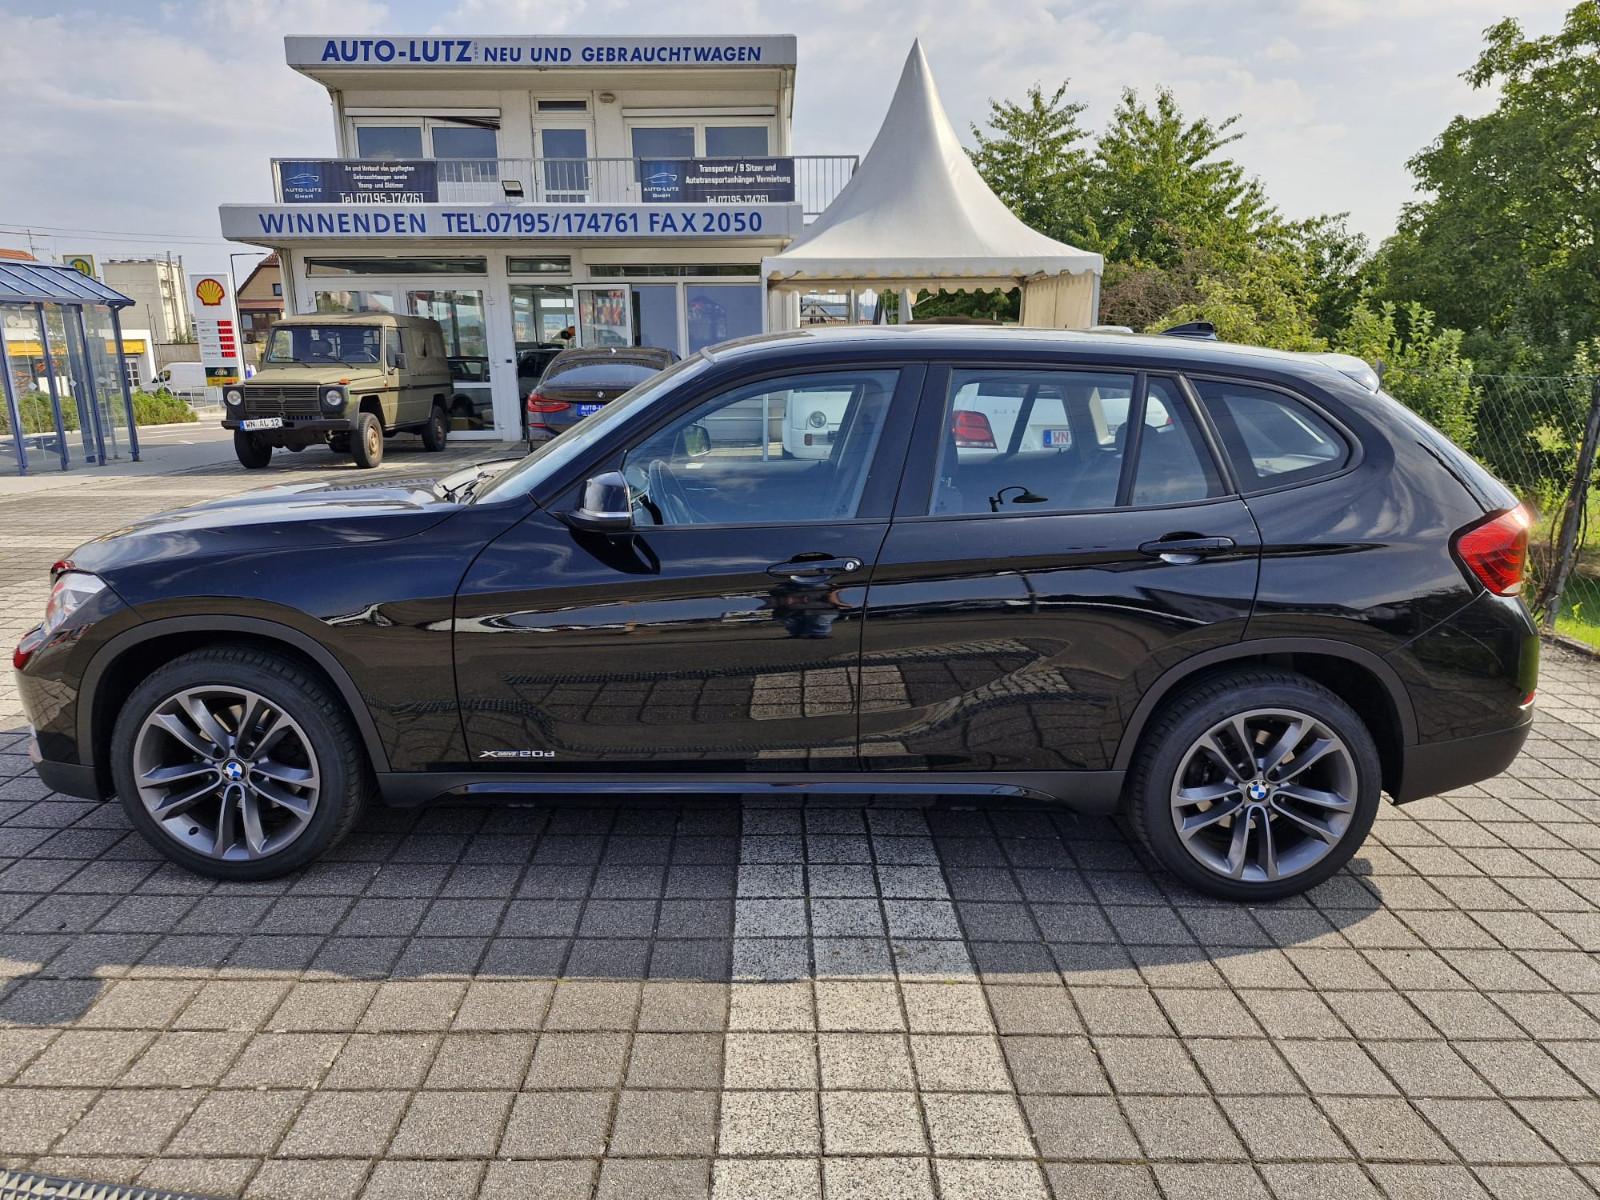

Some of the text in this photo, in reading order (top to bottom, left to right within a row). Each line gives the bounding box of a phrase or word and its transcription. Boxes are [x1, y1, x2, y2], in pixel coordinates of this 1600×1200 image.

[321, 40, 472, 62] AUTO-LUTZ
[484, 47, 521, 62] NEU
[530, 47, 572, 62] UND
[581, 46, 762, 62] GEBRAUCHTWAGEN
[699, 164, 734, 174] Transporter
[746, 163, 763, 172] Sitzer
[765, 163, 777, 172] und
[685, 174, 791, 185] Autotransportanhänger Vermietung
[258, 213, 426, 233] WINNENDEN
[649, 212, 698, 233] FAX
[702, 212, 763, 233] 2050
[1053, 431, 1069, 443] WN
